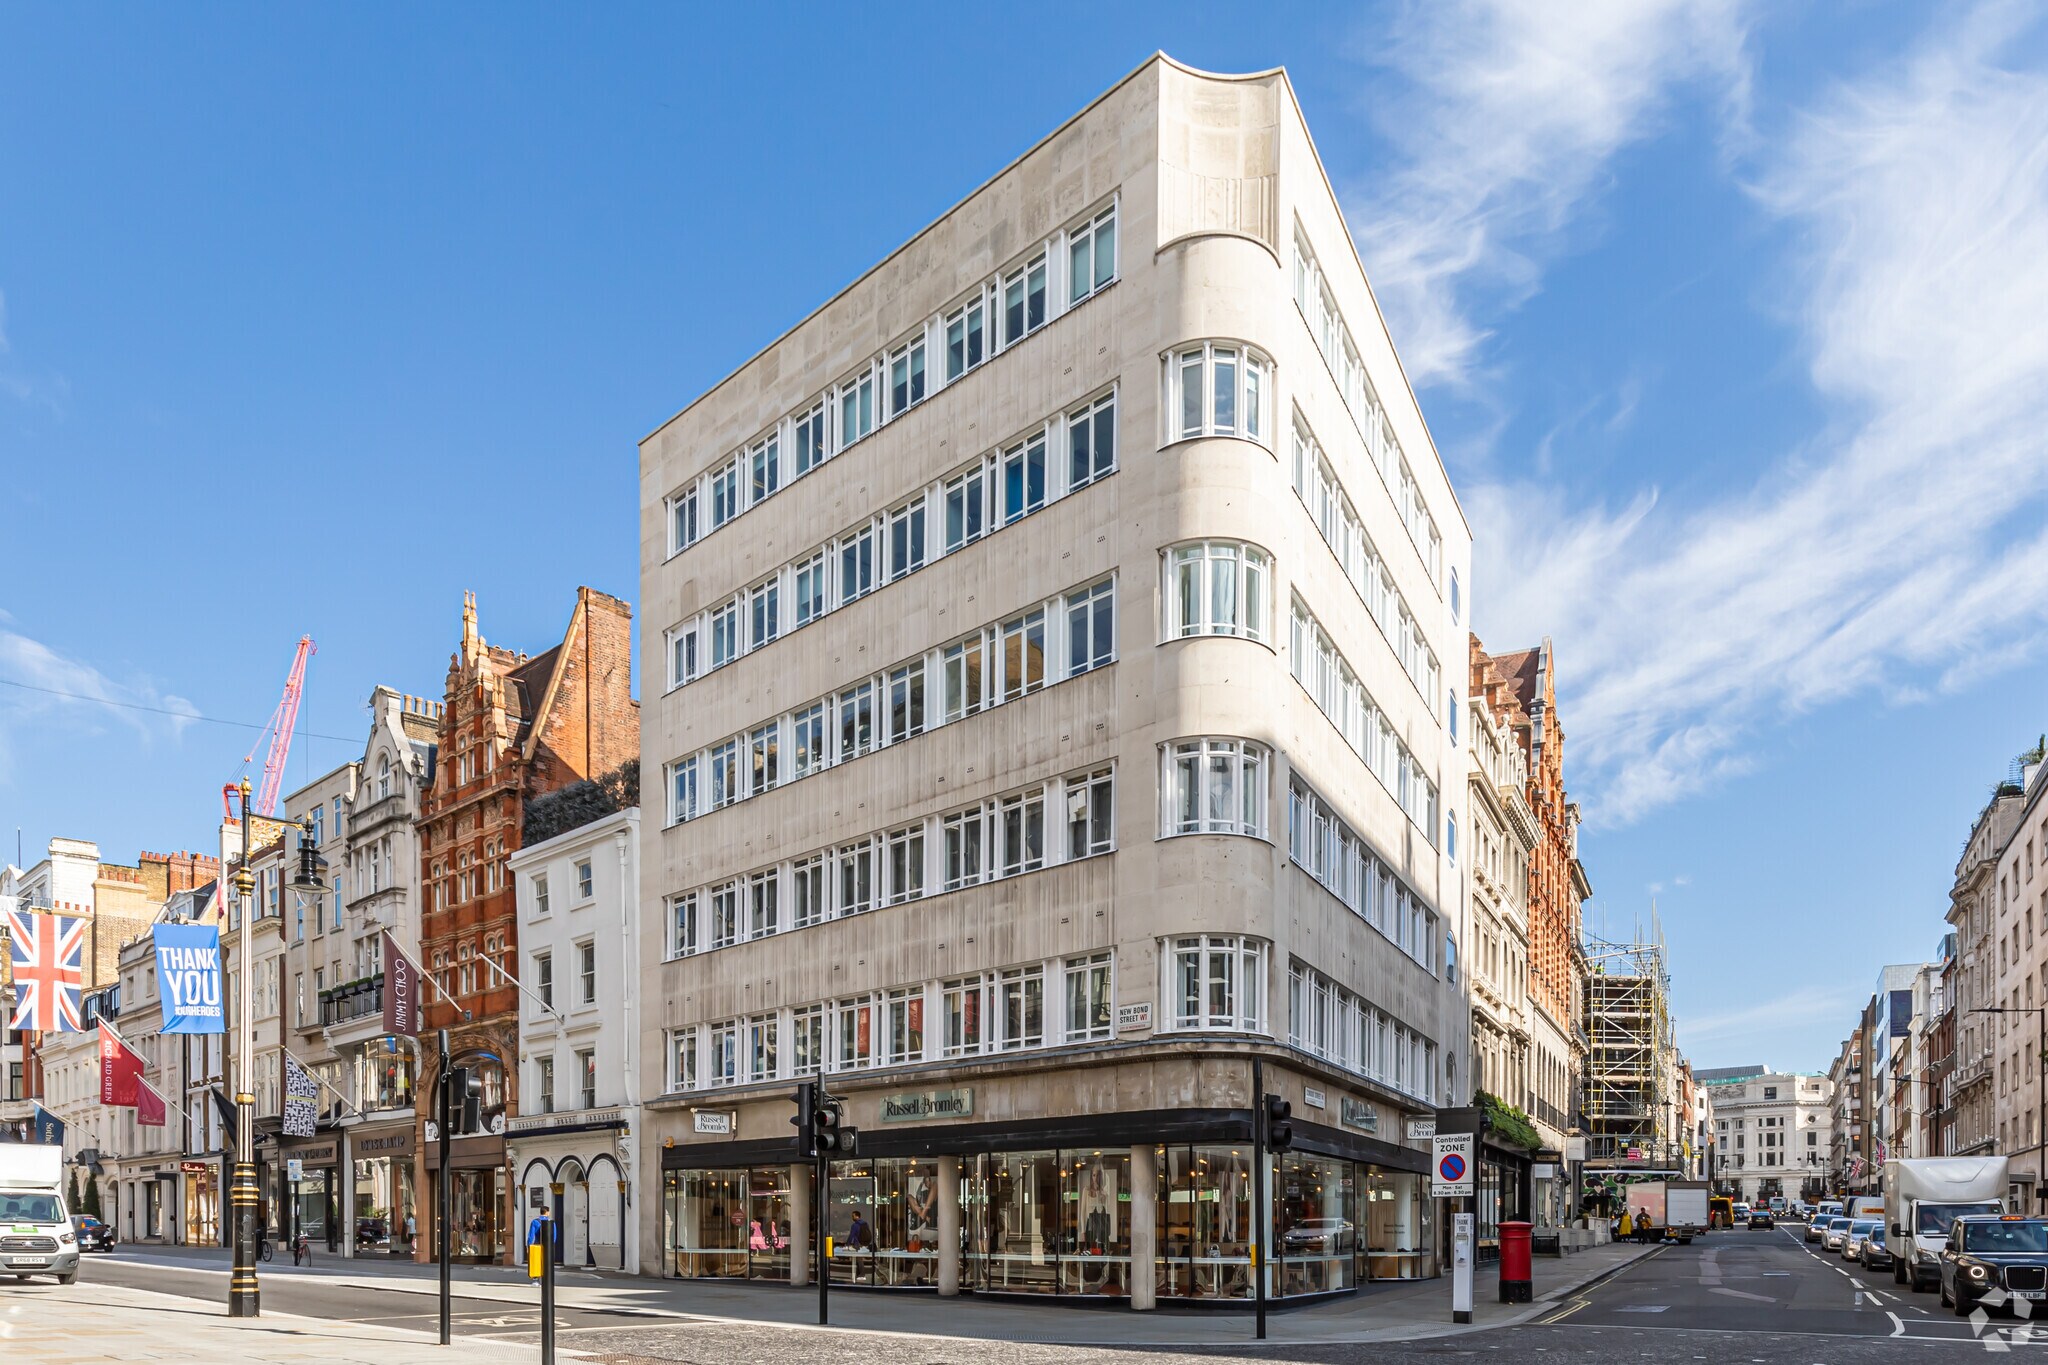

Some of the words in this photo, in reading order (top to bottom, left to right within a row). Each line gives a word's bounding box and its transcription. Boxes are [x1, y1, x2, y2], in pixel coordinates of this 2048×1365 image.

[158, 947, 217, 970] THANK
[164, 970, 220, 1006] YOU
[394, 958, 407, 997] CHOO
[395, 999, 407, 1031] JIMMY
[1120, 1015, 1138, 1023] STREET
[1140, 1013, 1148, 1021] W1
[1133, 1005, 1148, 1013] BOND
[104, 1040, 113, 1077] RICHARD
[104, 1077, 113, 1102] GREEN
[886, 1099, 919, 1116] Russell
[923, 1095, 964, 1117] Bromley
[700, 1115, 723, 1123] Russell
[1435, 1136, 1471, 1144] Controlled
[1440, 1144, 1465, 1152] ZONE
